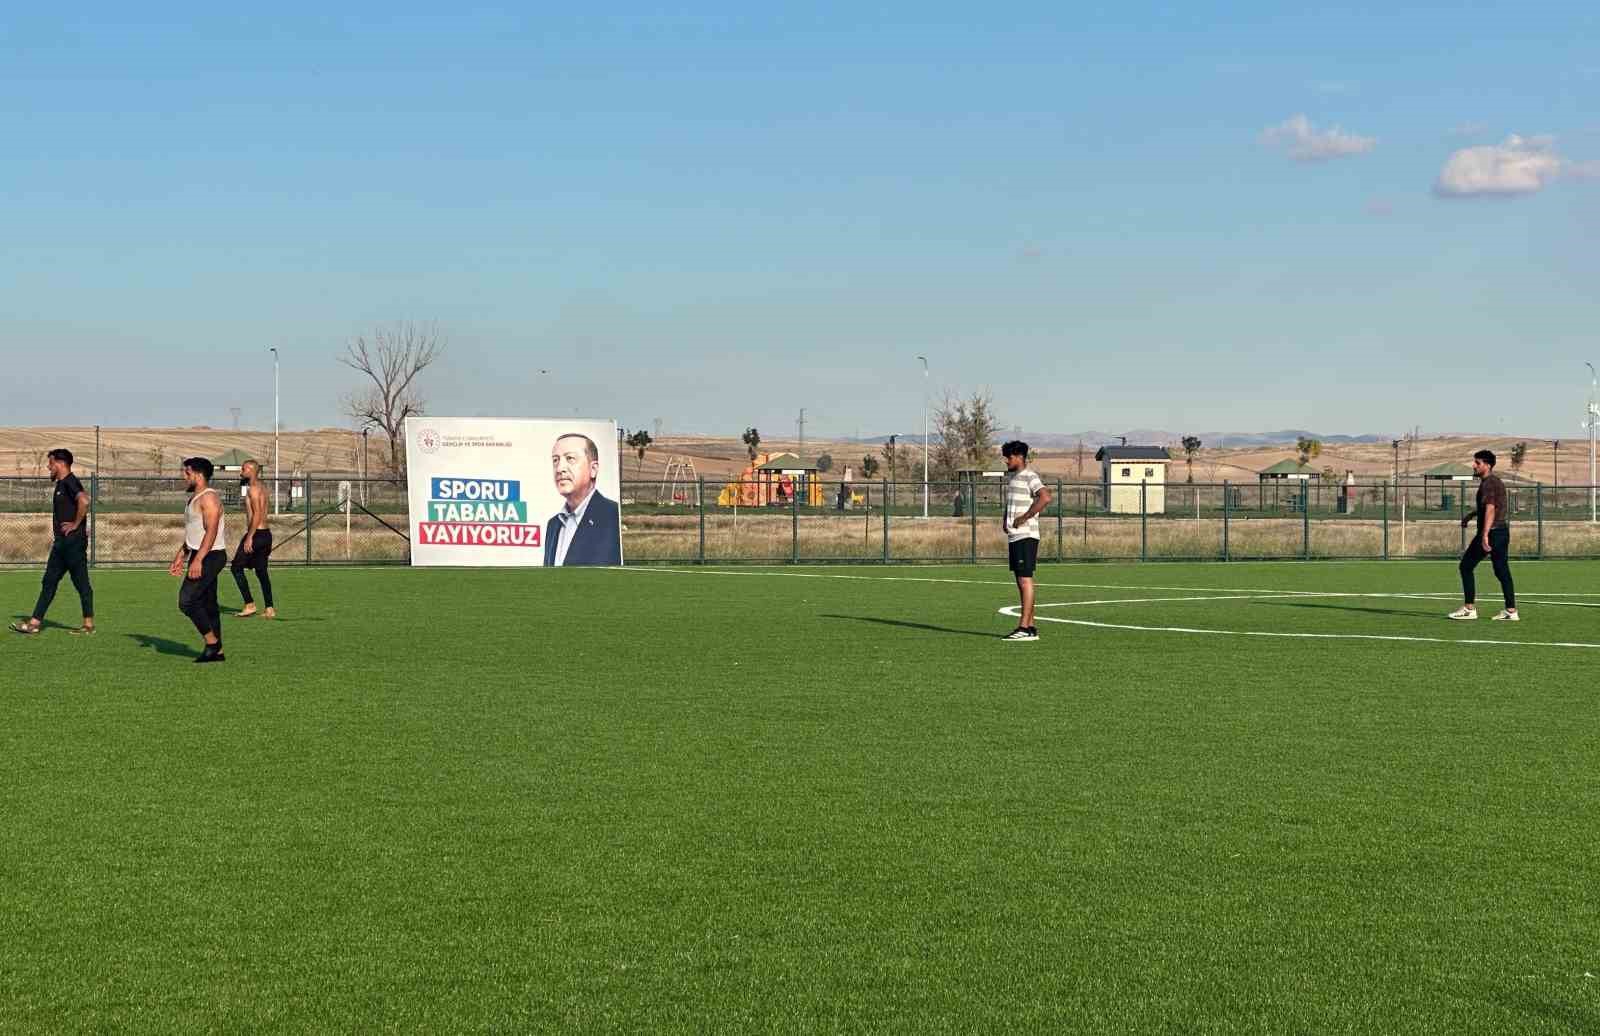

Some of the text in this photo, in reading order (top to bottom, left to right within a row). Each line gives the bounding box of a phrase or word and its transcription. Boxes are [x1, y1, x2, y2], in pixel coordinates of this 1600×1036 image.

[440, 480, 509, 500] SPORU
[434, 503, 519, 521] TABANA
[422, 525, 538, 545] YAYIYORUZ
